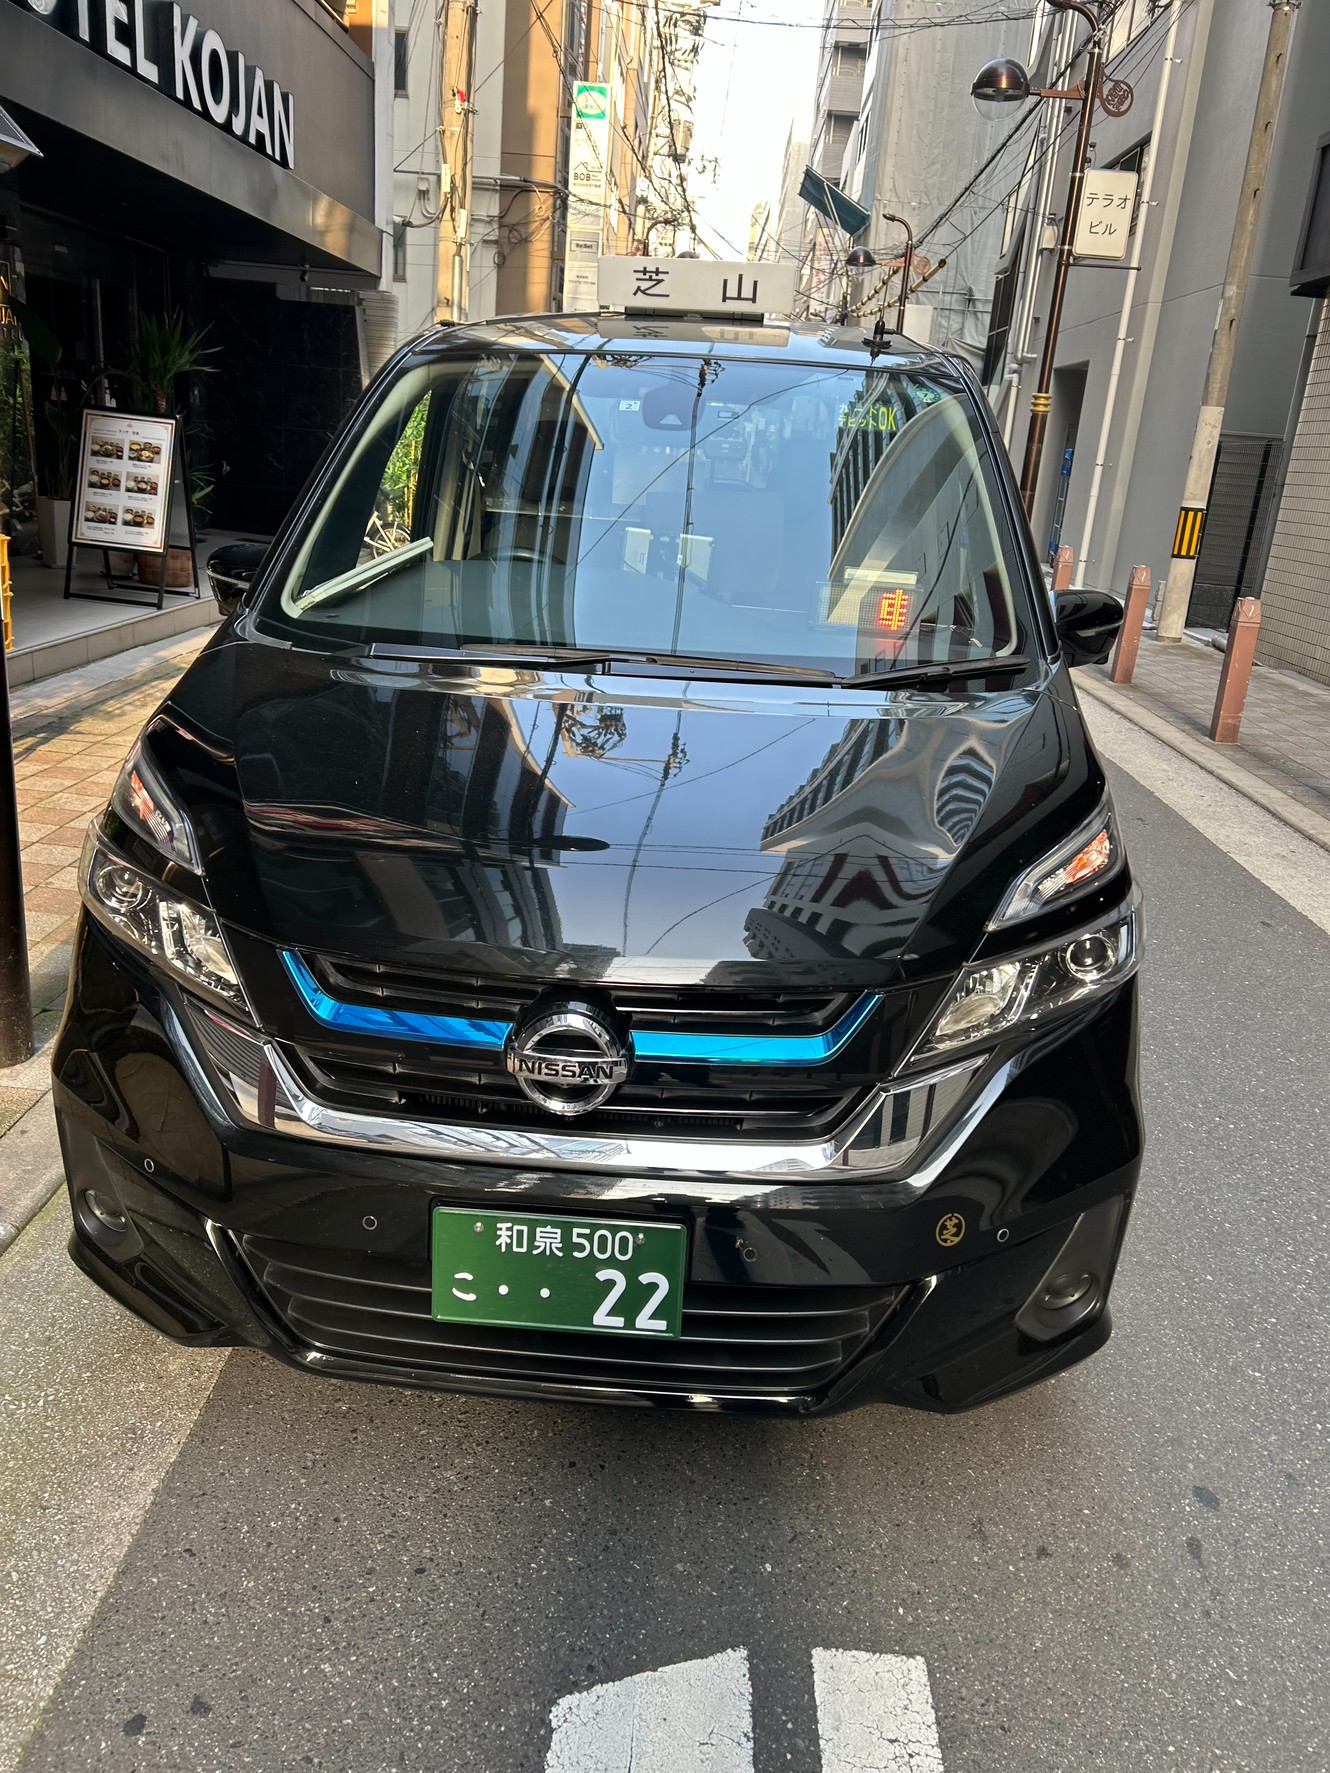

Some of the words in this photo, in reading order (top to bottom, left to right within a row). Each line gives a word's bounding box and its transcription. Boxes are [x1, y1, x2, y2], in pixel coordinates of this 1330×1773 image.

[172, 2, 295, 170] KOJAN
[574, 172, 591, 182] BOB
[1086, 193, 1131, 210] テラオ
[1088, 221, 1118, 236] ビル
[878, 407, 897, 431] OK
[879, 589, 908, 631] 車
[517, 1059, 614, 1080] NISSAN
[496, 1222, 564, 1257] 和泉
[572, 1228, 634, 1261] 500
